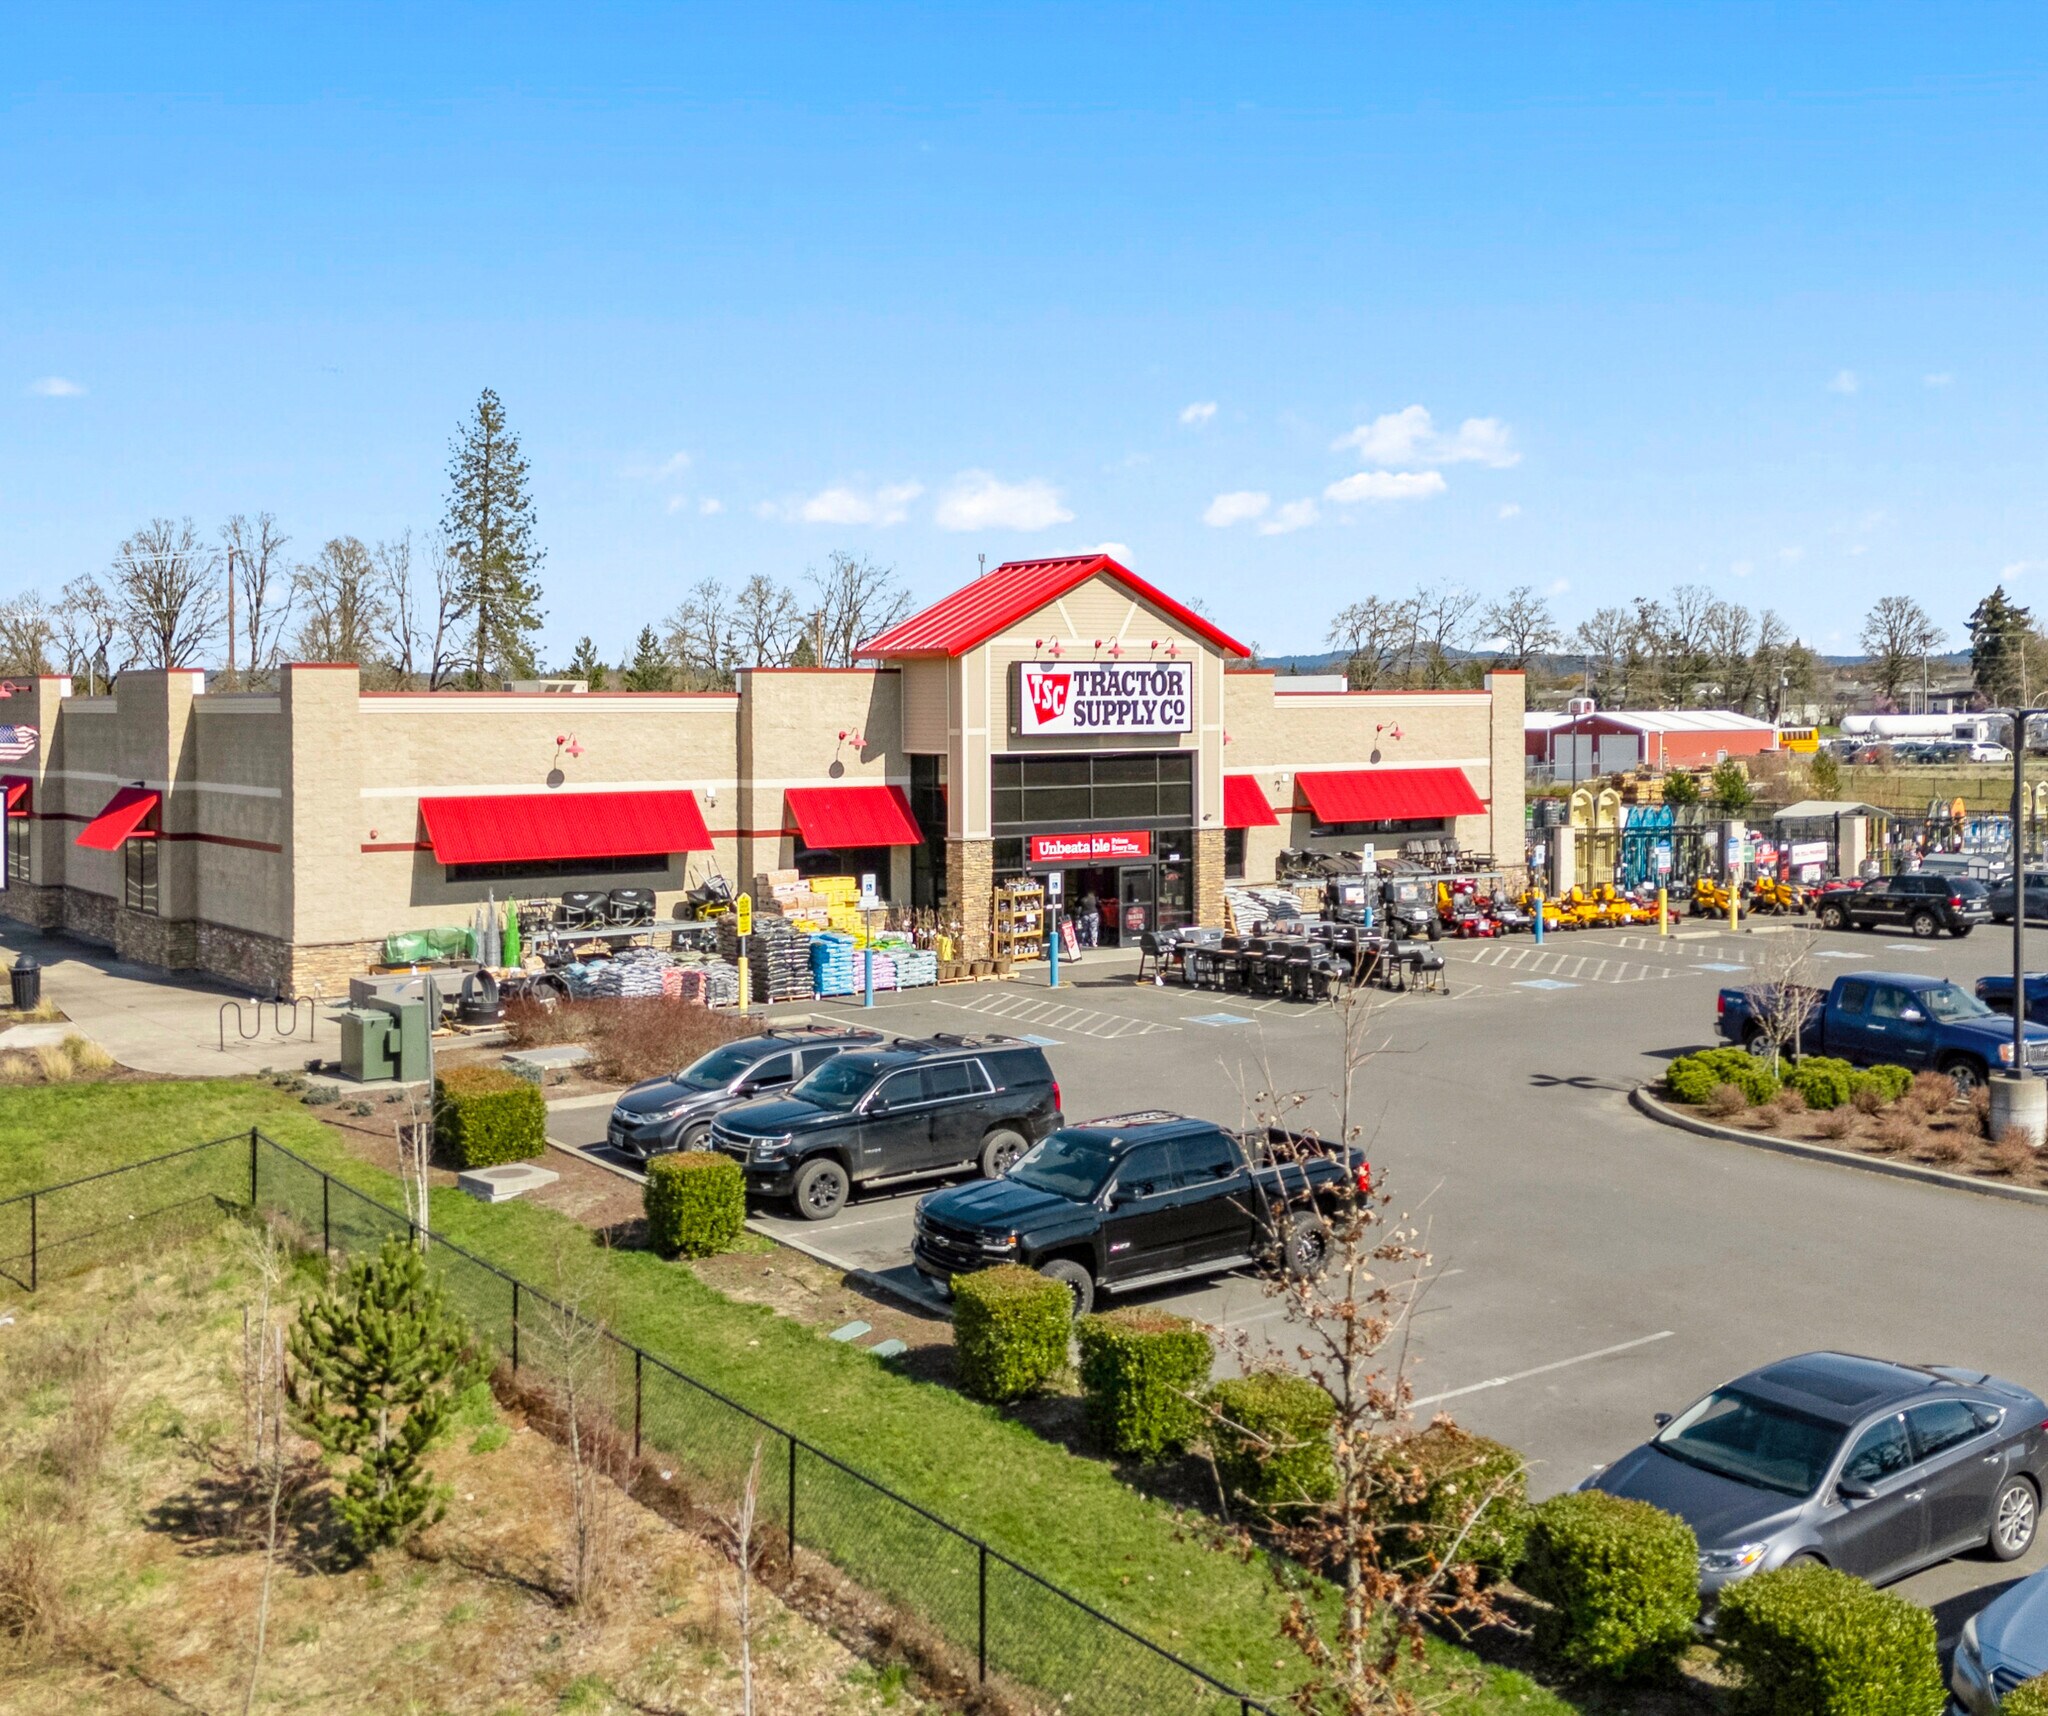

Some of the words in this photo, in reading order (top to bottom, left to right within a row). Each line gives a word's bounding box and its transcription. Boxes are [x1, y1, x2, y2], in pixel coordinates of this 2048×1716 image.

[1031, 675, 1064, 715] TSC
[1073, 670, 1184, 697] TRACTOR
[1073, 700, 1158, 727] SUPPLY
[1039, 838, 1110, 855] Unbeatable
